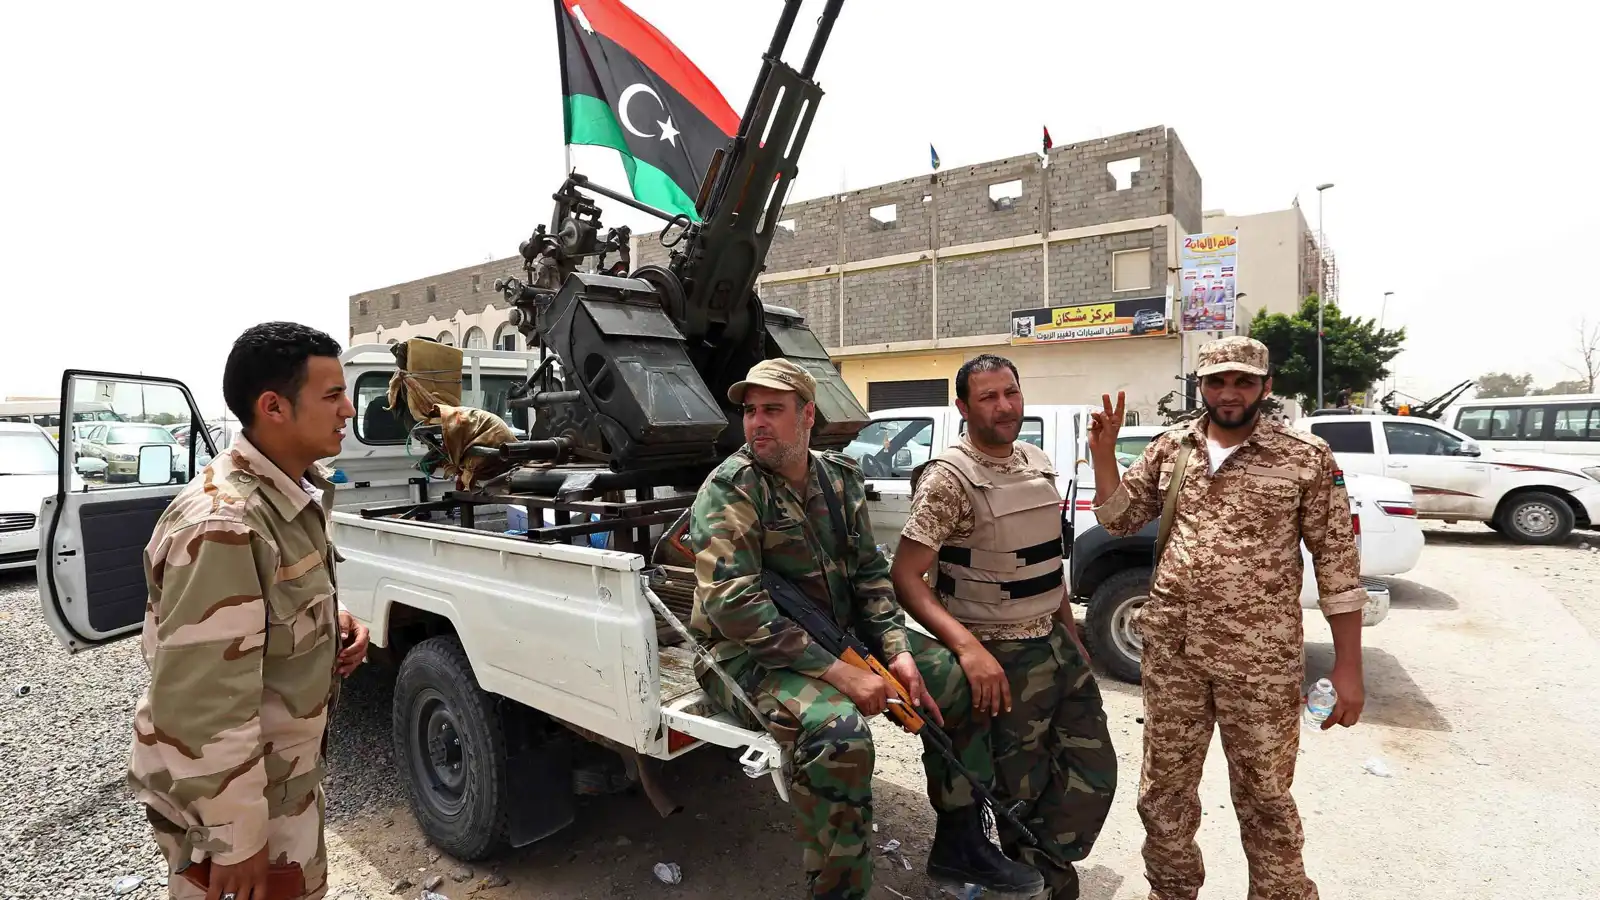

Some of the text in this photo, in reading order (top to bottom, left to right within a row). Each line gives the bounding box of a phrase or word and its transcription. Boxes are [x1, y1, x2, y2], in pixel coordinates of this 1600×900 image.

[1217, 236, 1236, 248] عالم
[1089, 308, 1113, 323] مركز
[1036, 326, 1128, 341] لغسيل السيارات وتغيير الزيوت
